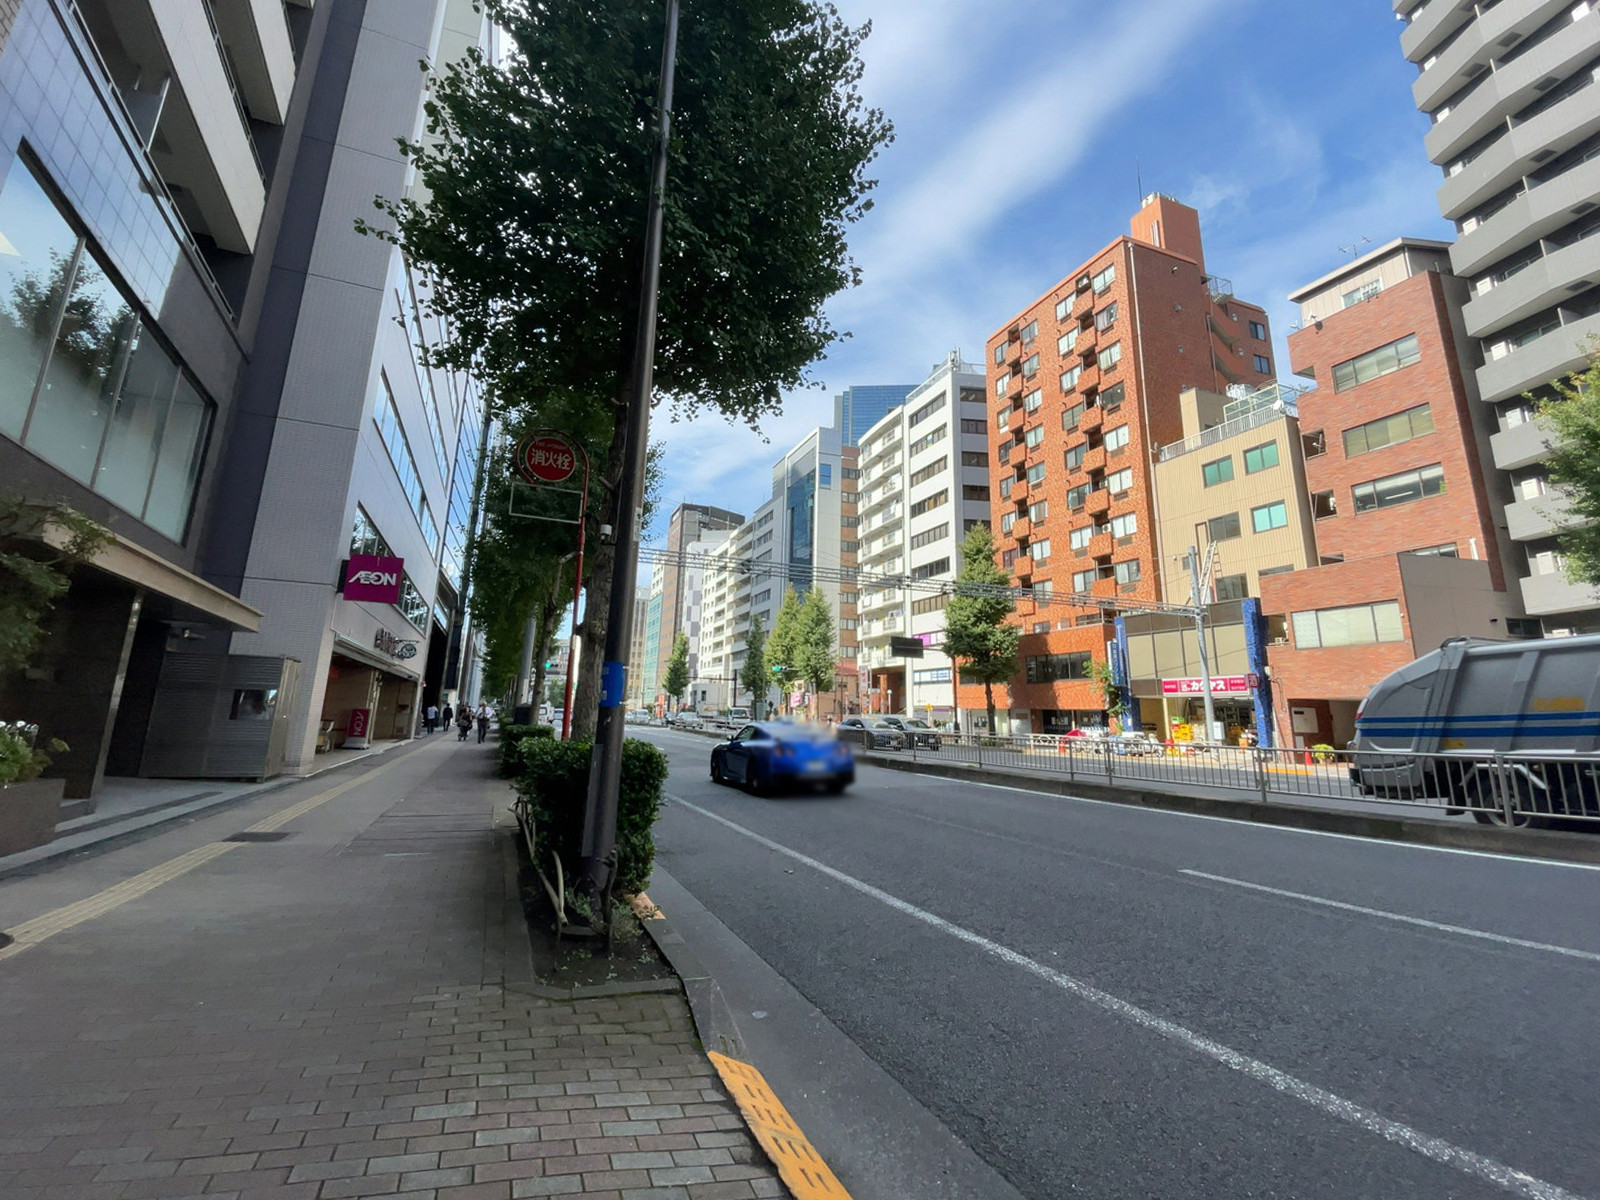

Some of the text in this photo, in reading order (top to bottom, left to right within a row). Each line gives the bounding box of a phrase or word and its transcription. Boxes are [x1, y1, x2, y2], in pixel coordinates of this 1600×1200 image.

[530, 448, 572, 470] 消火栓
[348, 570, 397, 587] AEON
